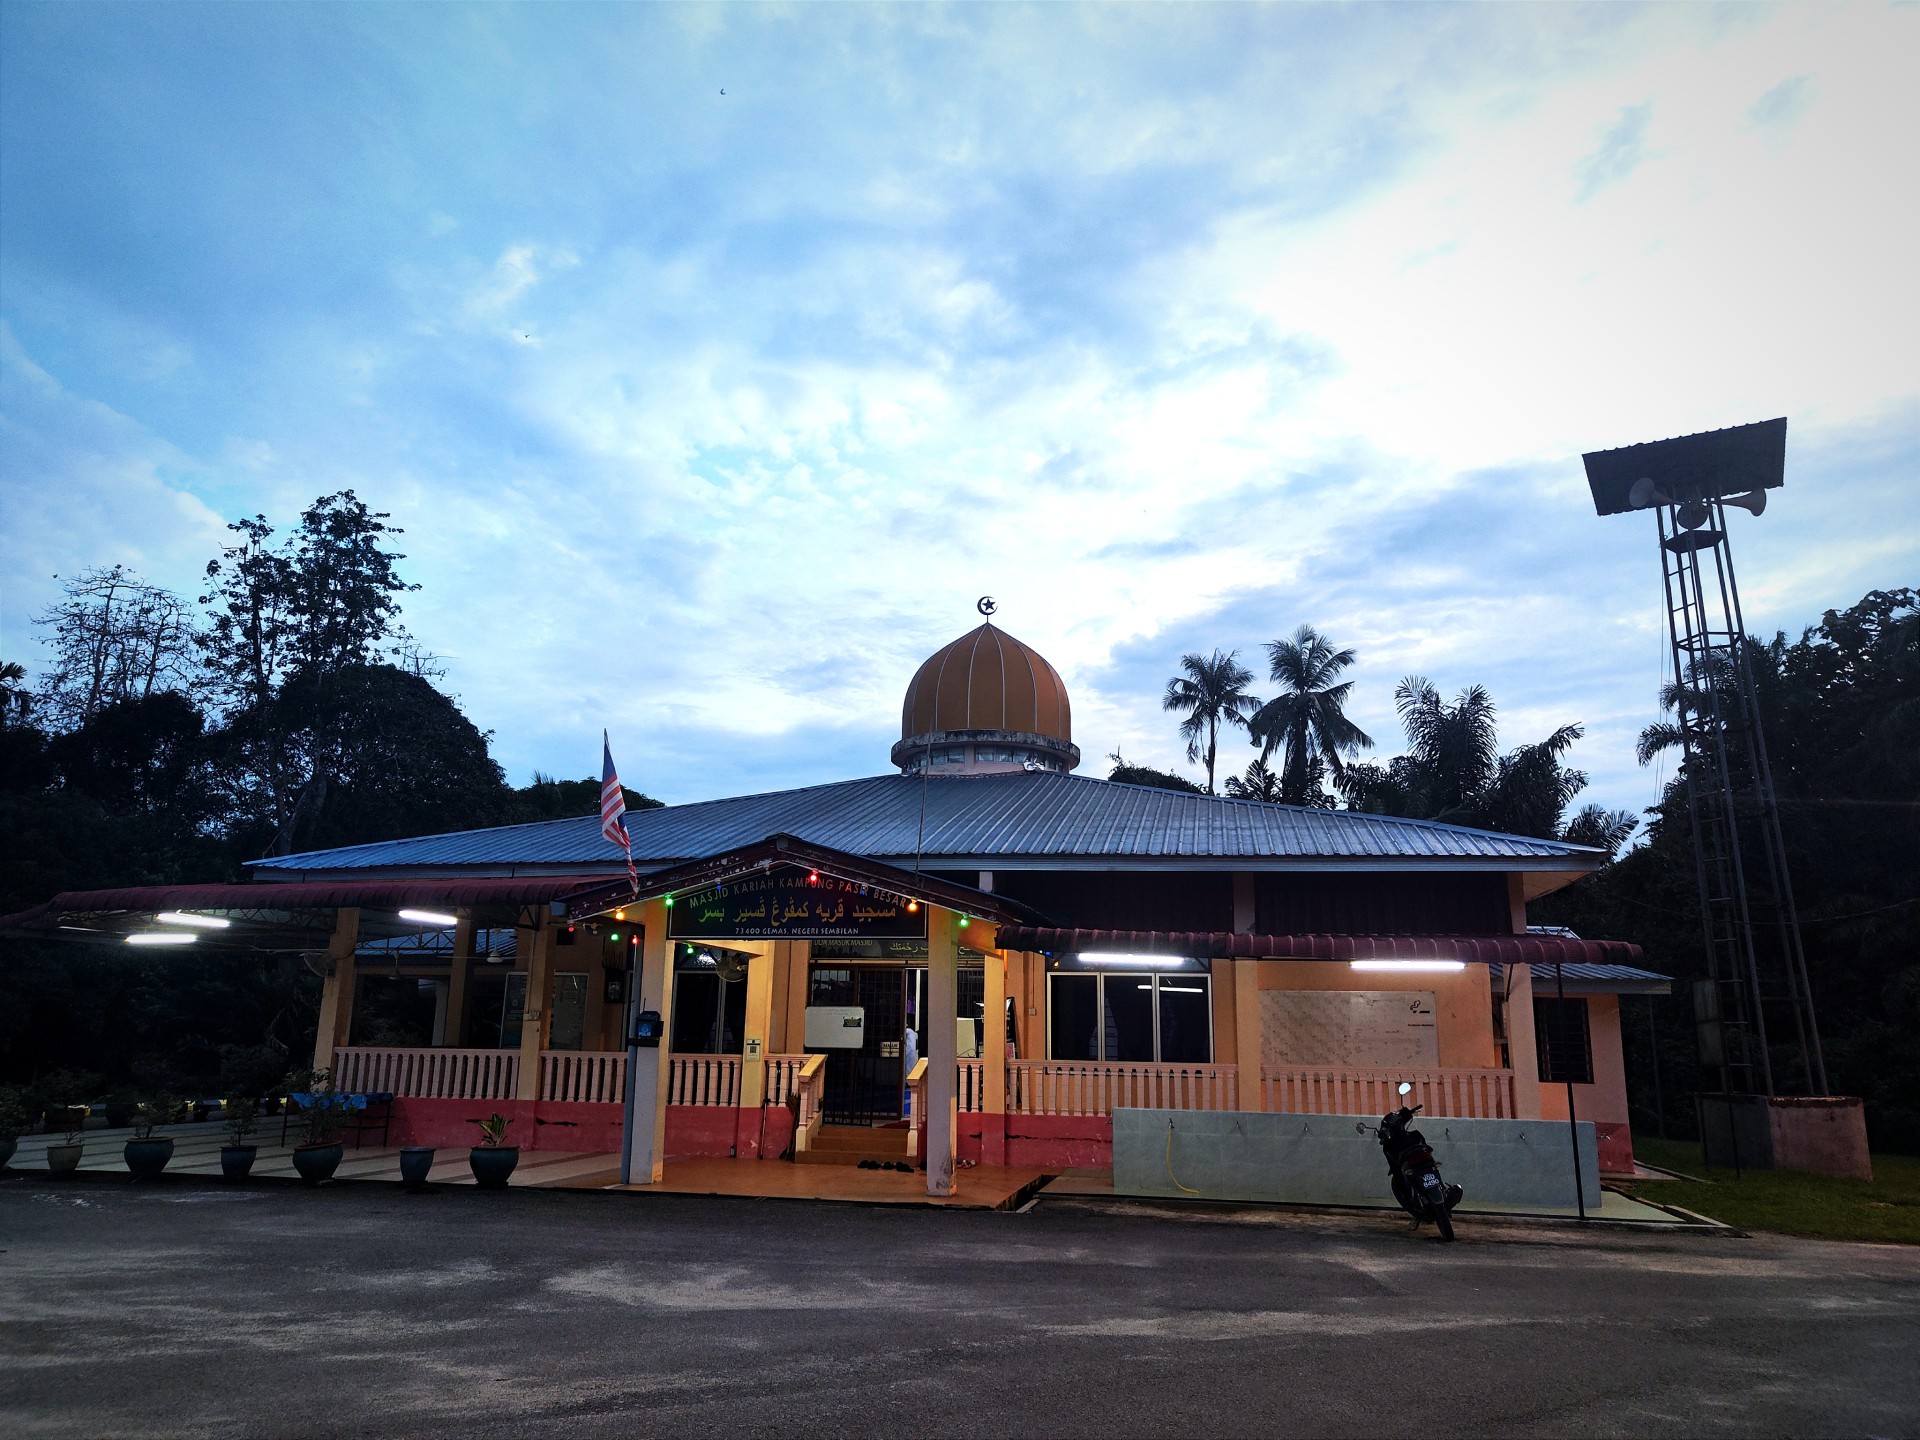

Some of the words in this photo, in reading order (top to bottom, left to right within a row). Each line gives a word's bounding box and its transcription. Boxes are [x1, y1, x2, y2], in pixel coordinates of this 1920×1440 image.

[689, 887, 729, 909] MASJID
[733, 879, 774, 895] KARIAH
[779, 877, 834, 890] KAMPUNG
[873, 889, 907, 908] BESAR
